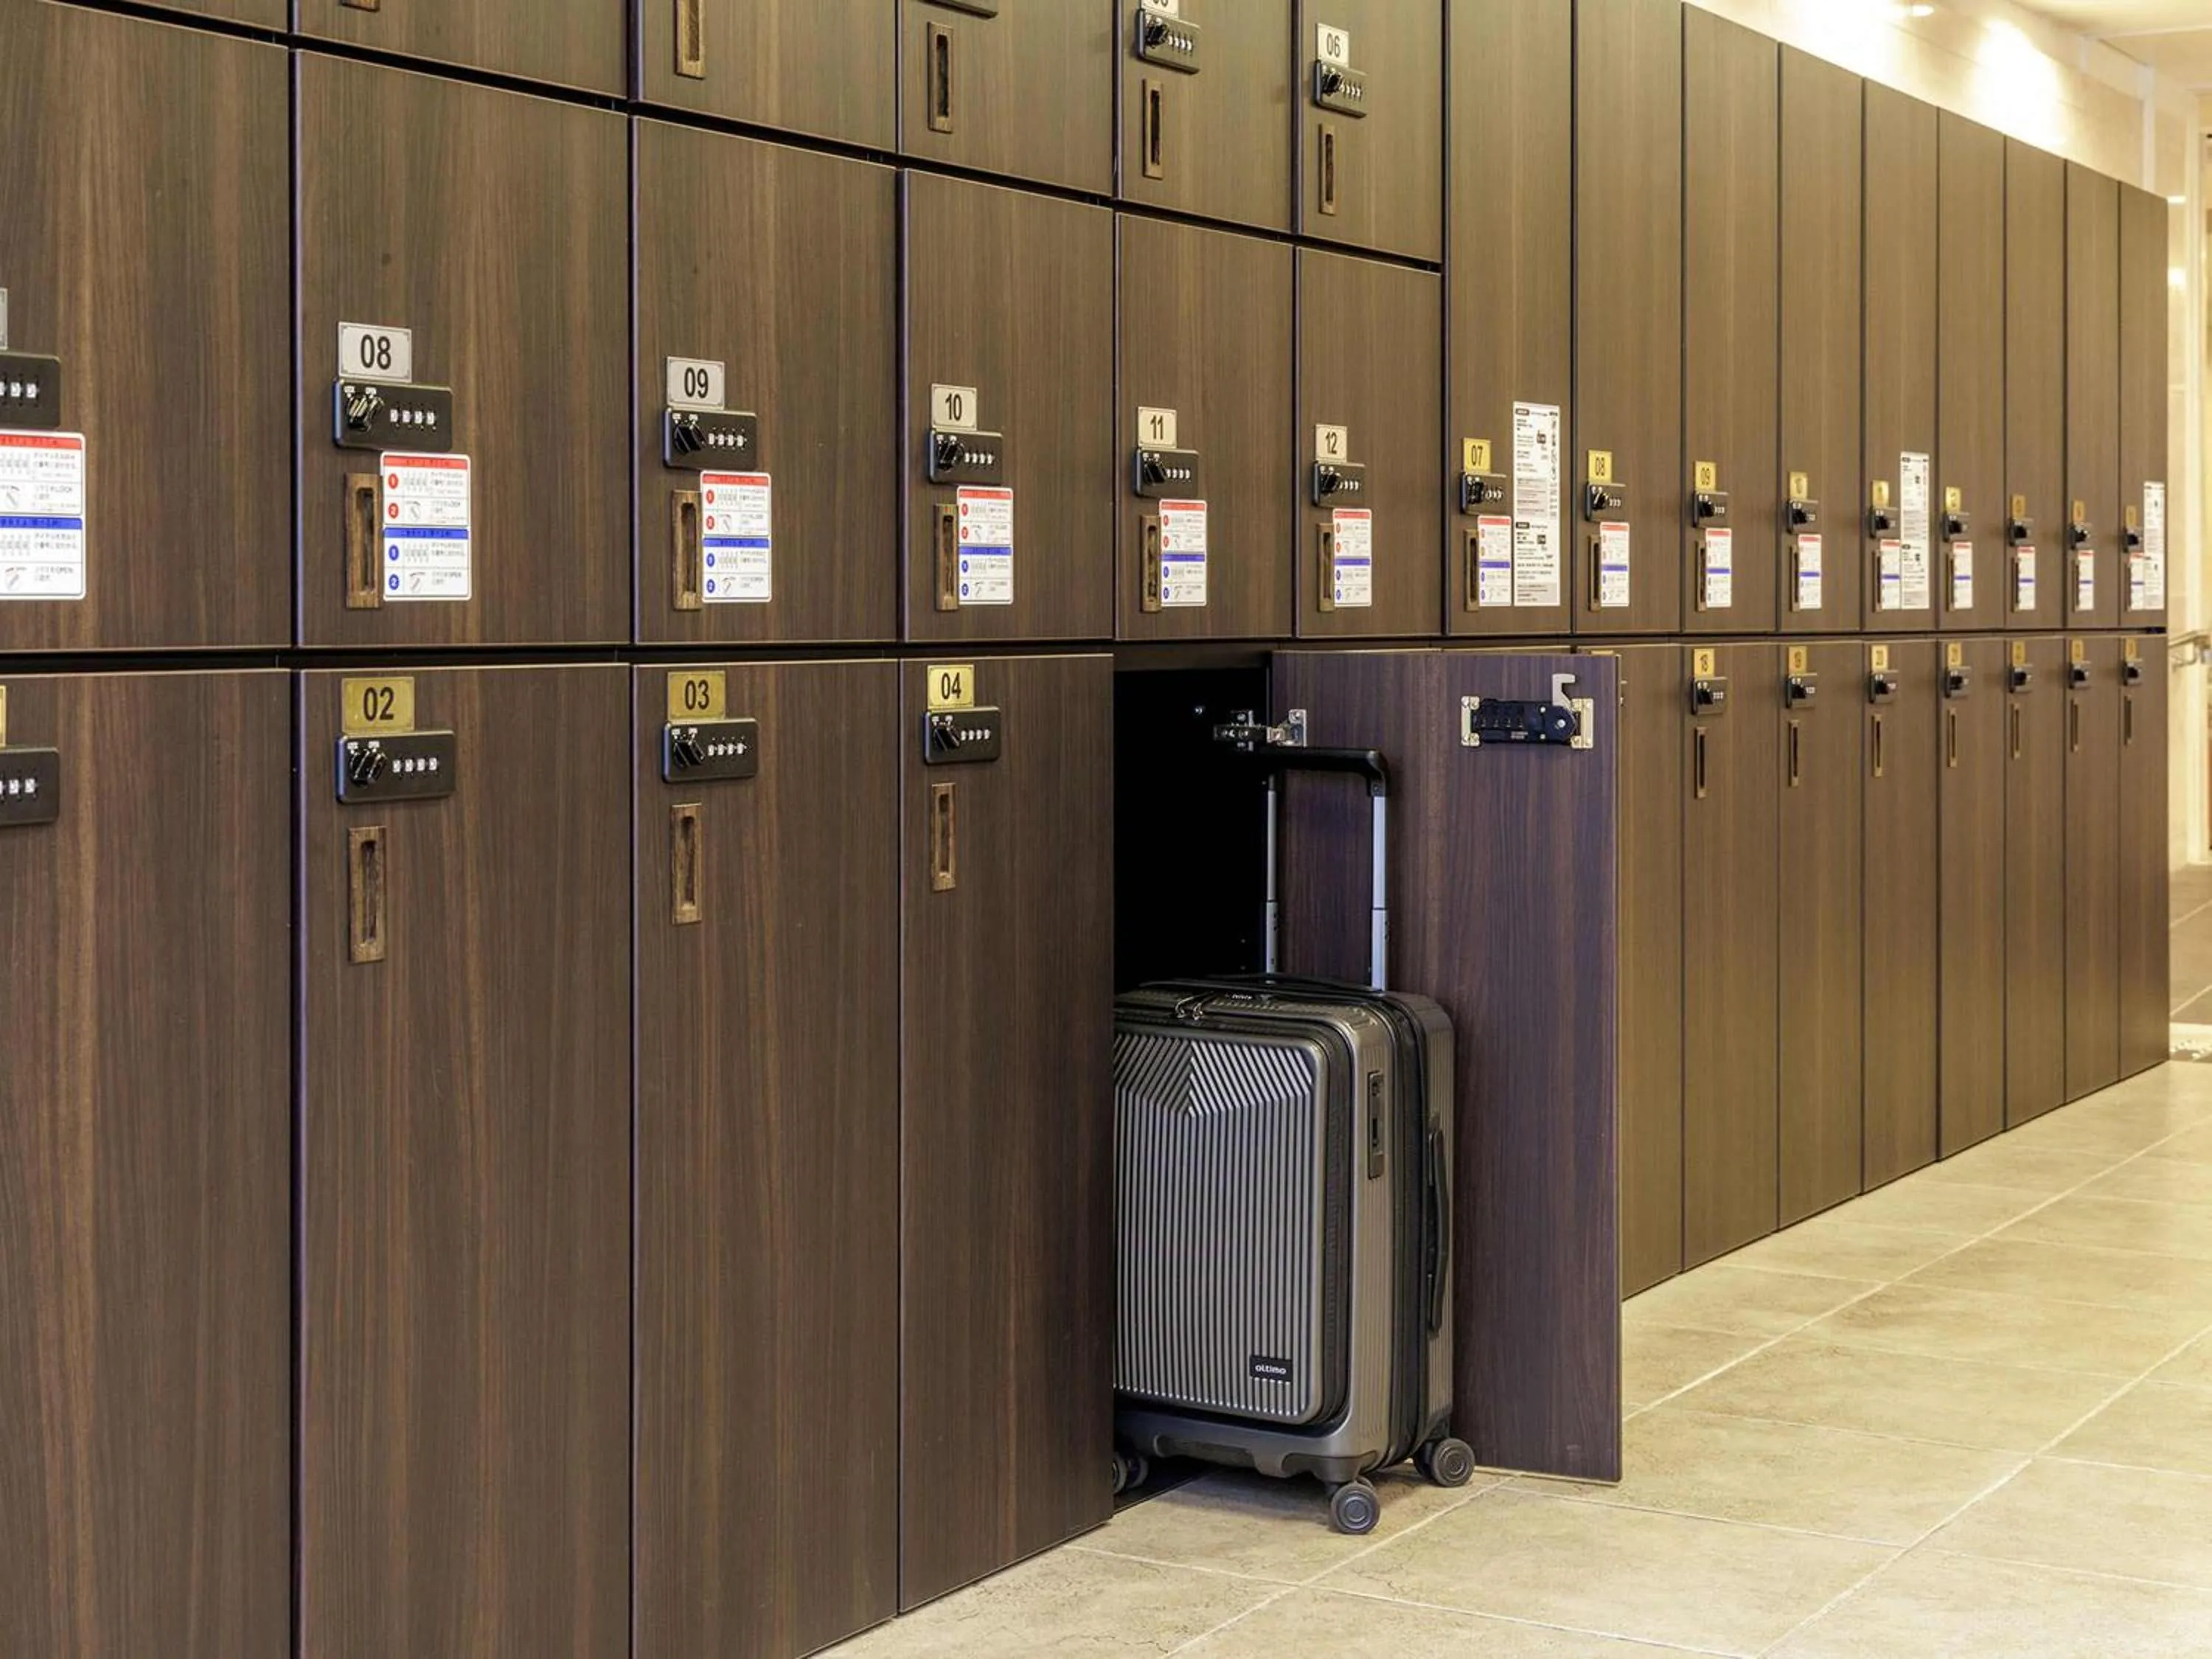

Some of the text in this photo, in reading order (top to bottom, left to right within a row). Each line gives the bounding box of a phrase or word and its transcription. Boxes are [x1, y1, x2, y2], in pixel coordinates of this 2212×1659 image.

[1327, 32, 1341, 58] 06
[361, 334, 392, 370] 08
[684, 367, 709, 399] 09
[945, 393, 962, 421] 10
[1150, 415, 1164, 440] 11
[1325, 431, 1338, 454] 12
[1471, 445, 1484, 466] 07
[685, 680, 709, 710] 03
[941, 672, 961, 700] 04
[364, 686, 395, 721] 02
